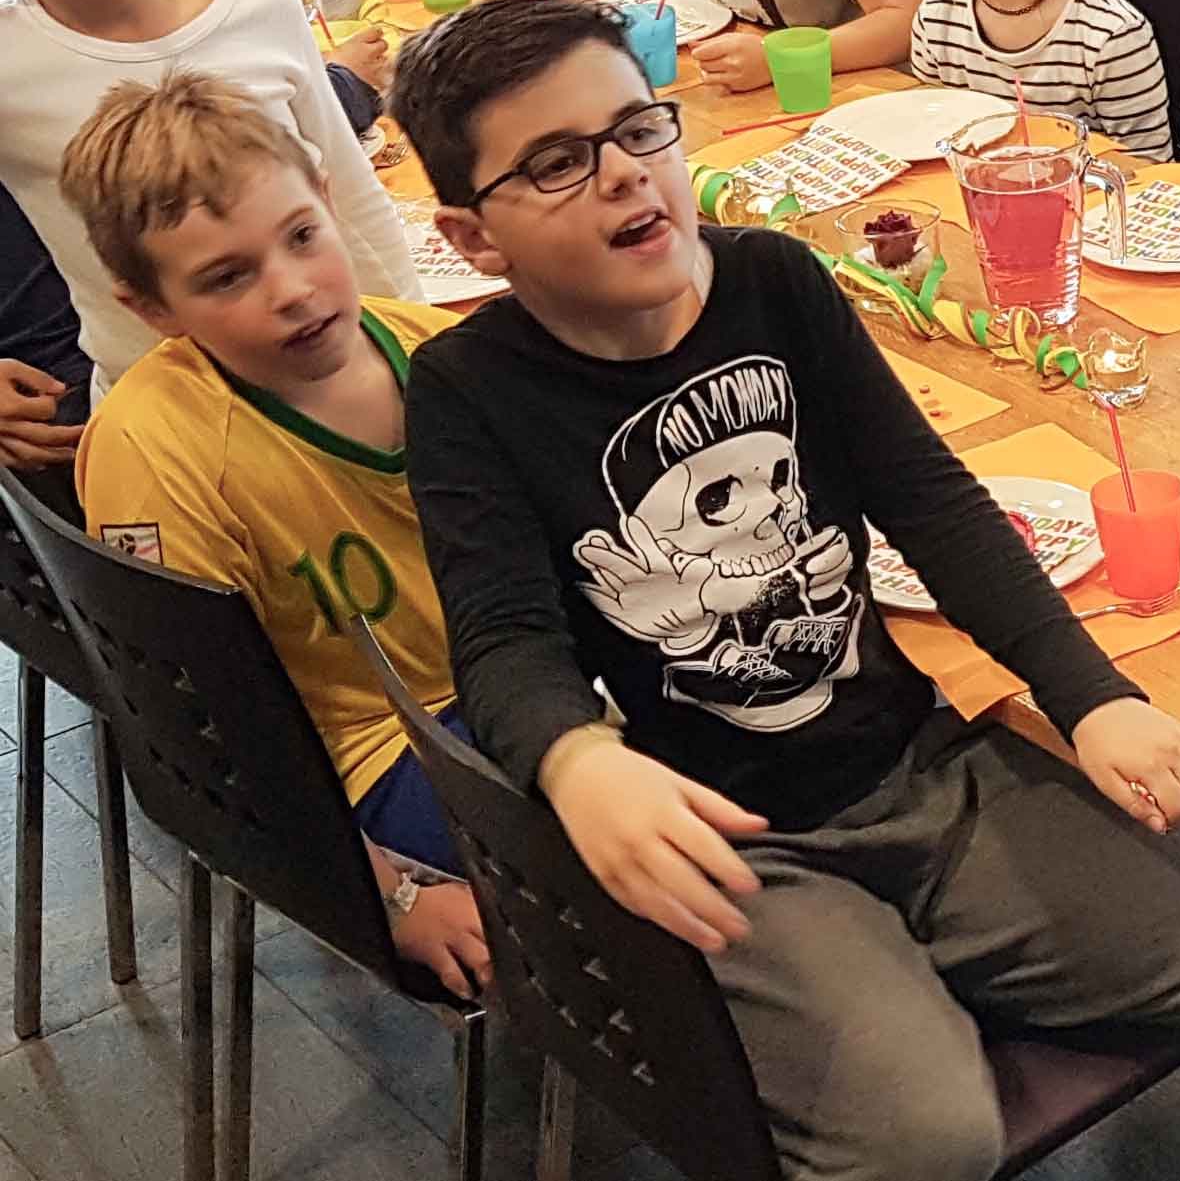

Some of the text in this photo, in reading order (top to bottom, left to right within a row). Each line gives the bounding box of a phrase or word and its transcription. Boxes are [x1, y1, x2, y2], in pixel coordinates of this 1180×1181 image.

[833, 151, 884, 180] HAPPY
[662, 365, 786, 457] NO MONDAY
[289, 529, 398, 636] 10
